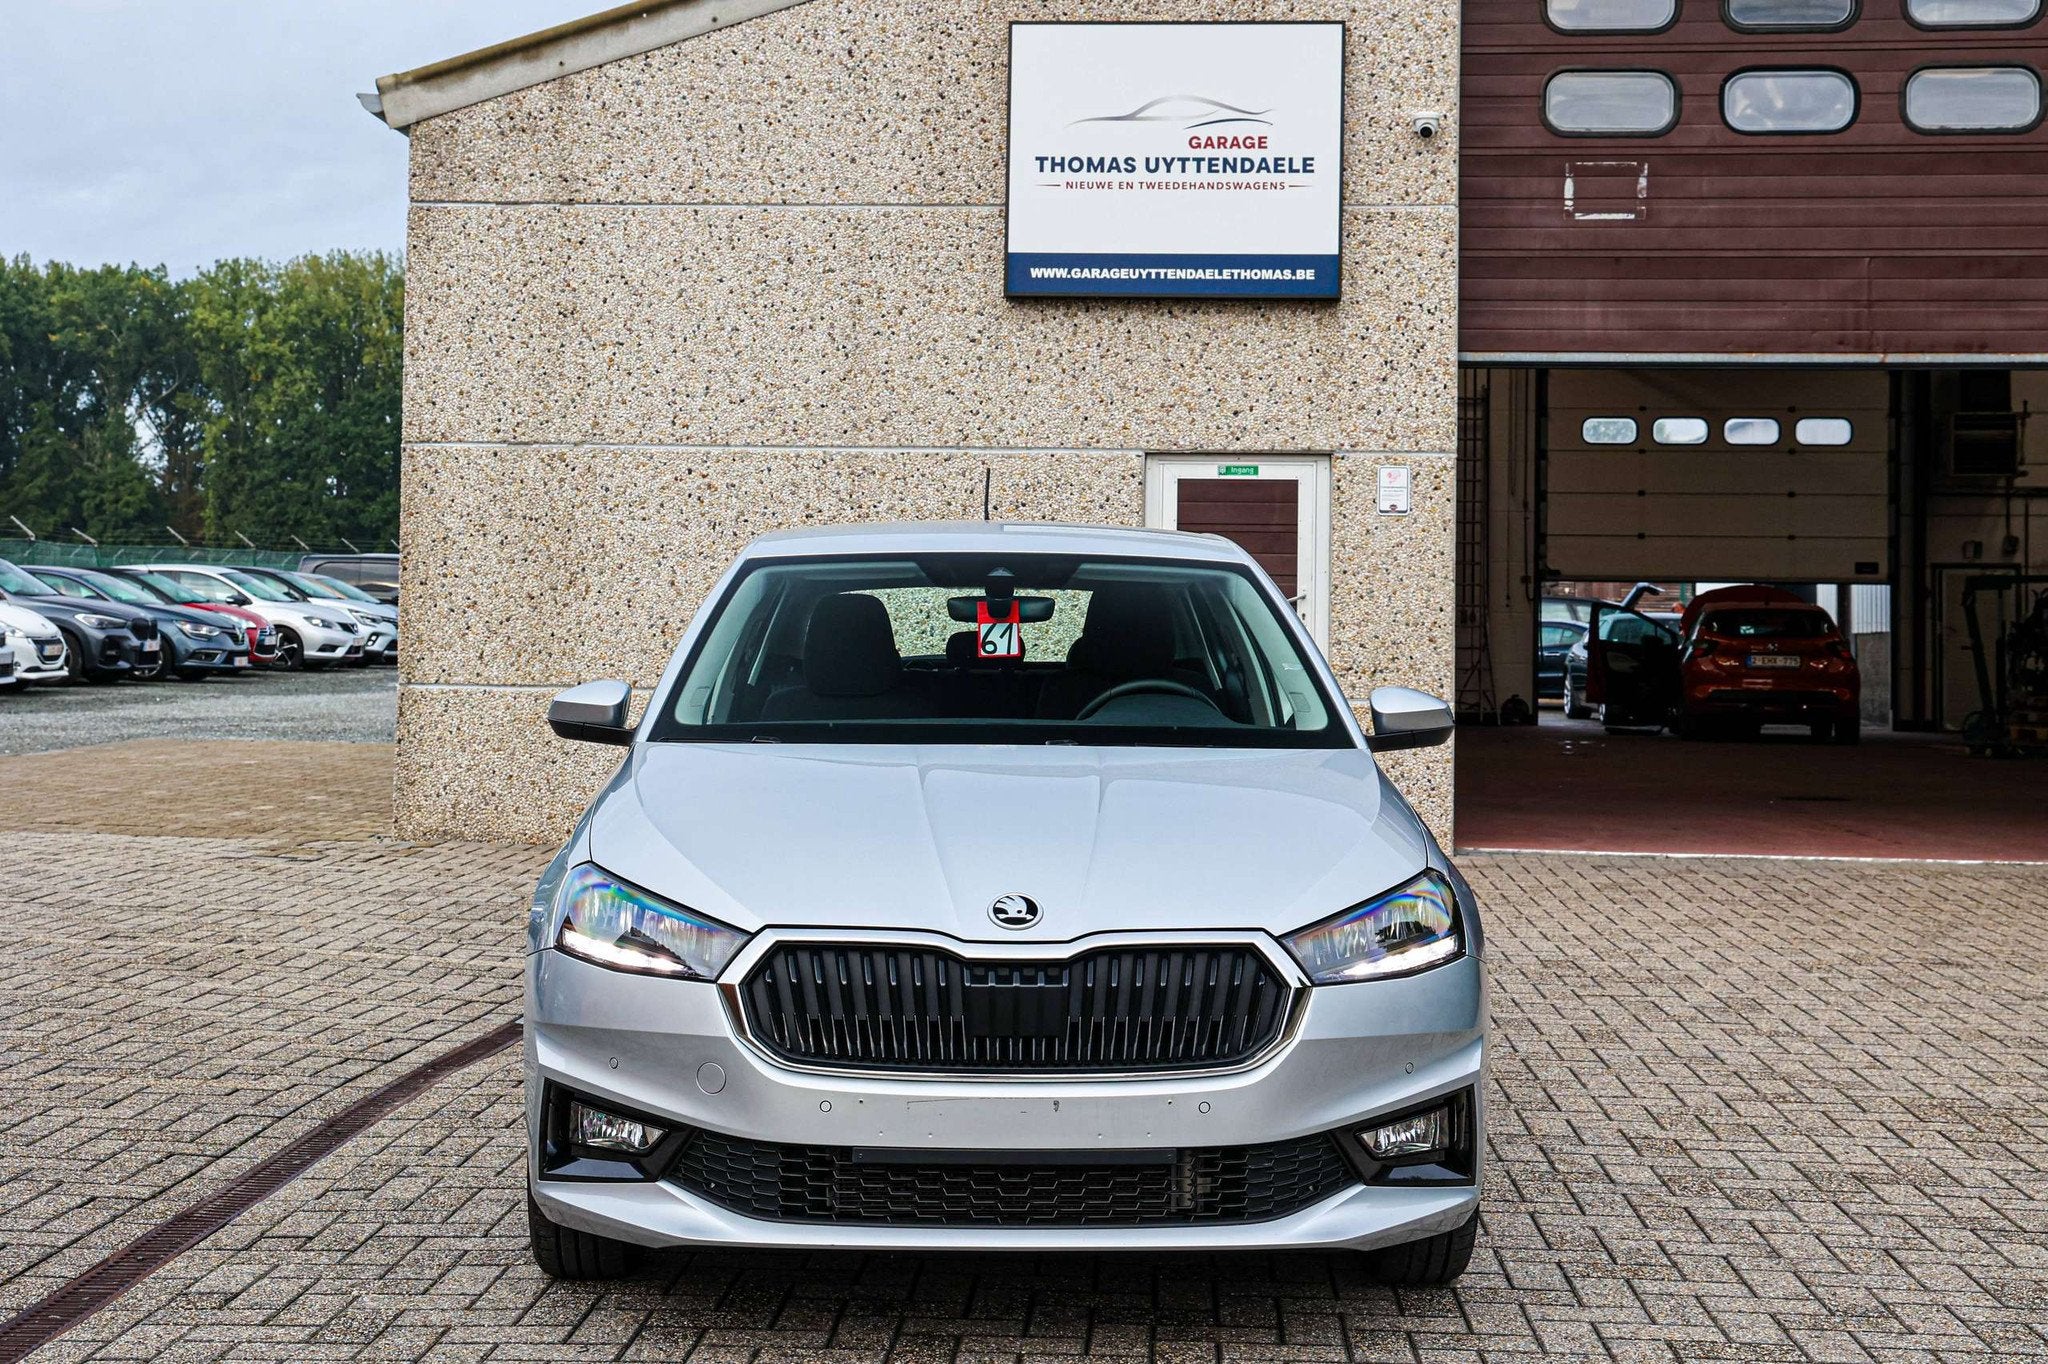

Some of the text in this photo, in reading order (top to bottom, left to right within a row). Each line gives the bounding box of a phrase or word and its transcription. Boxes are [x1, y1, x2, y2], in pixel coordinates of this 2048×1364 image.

[1188, 135, 1268, 149] GARAGE
[1035, 156, 1315, 174] THOMAS UYTTENDAELE
[1065, 181, 1286, 191] NIEUWE EN TWEEDEHANDSWAGENS
[1030, 267, 1316, 281] WWW.GARAGEUYTTENDAELETHOMAS.BE
[1230, 466, 1254, 475] Ingang
[981, 622, 1014, 655] 61
